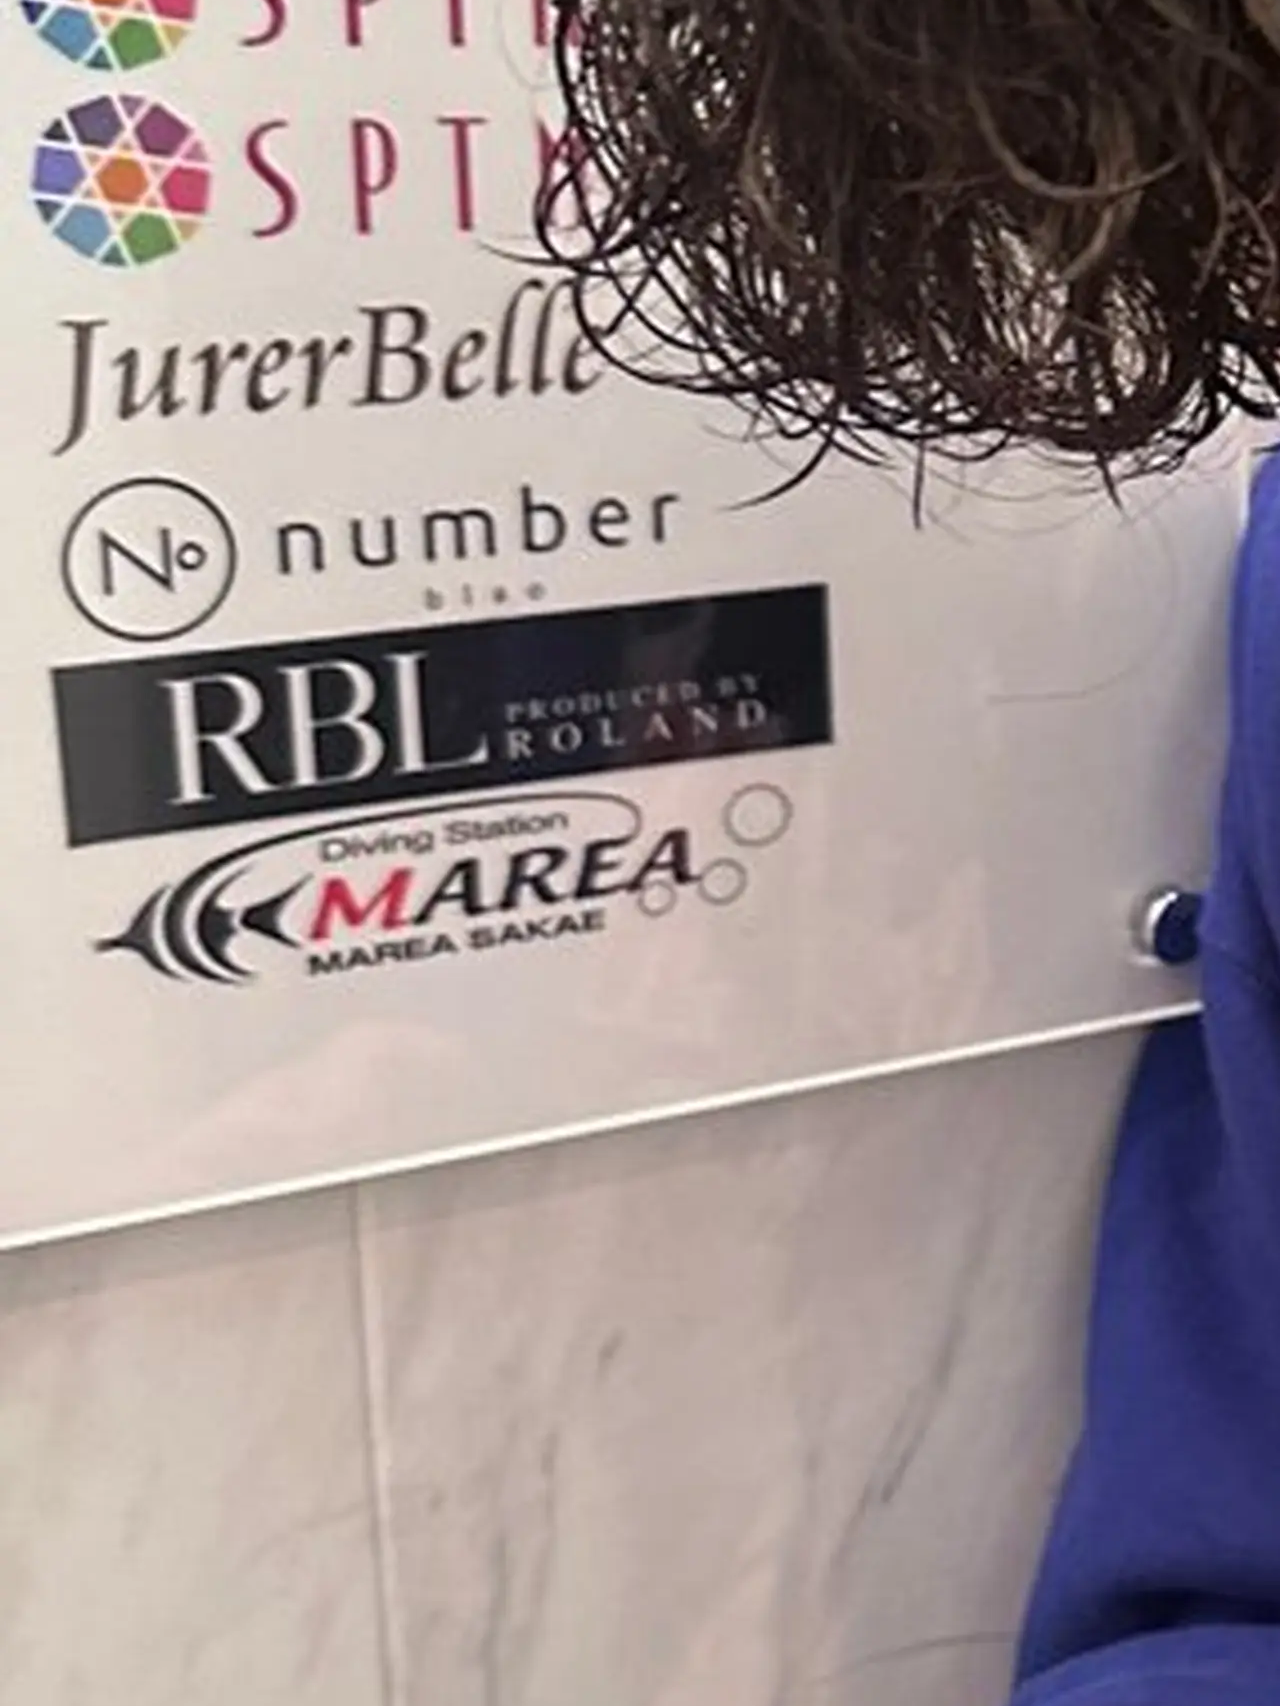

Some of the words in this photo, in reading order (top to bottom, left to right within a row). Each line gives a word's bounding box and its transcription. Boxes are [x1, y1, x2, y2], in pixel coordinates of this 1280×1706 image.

[53, 278, 604, 456] JurerBelle
[276, 485, 680, 575] number
[160, 649, 487, 807] RBL
[505, 698, 767, 759] ROLAND
[715, 673, 762, 695] BY
[319, 826, 434, 862] Diving
[443, 810, 569, 846] Station
[310, 827, 702, 941] MAREA
[307, 931, 458, 975] MAREA
[468, 908, 606, 950] SAKAE
